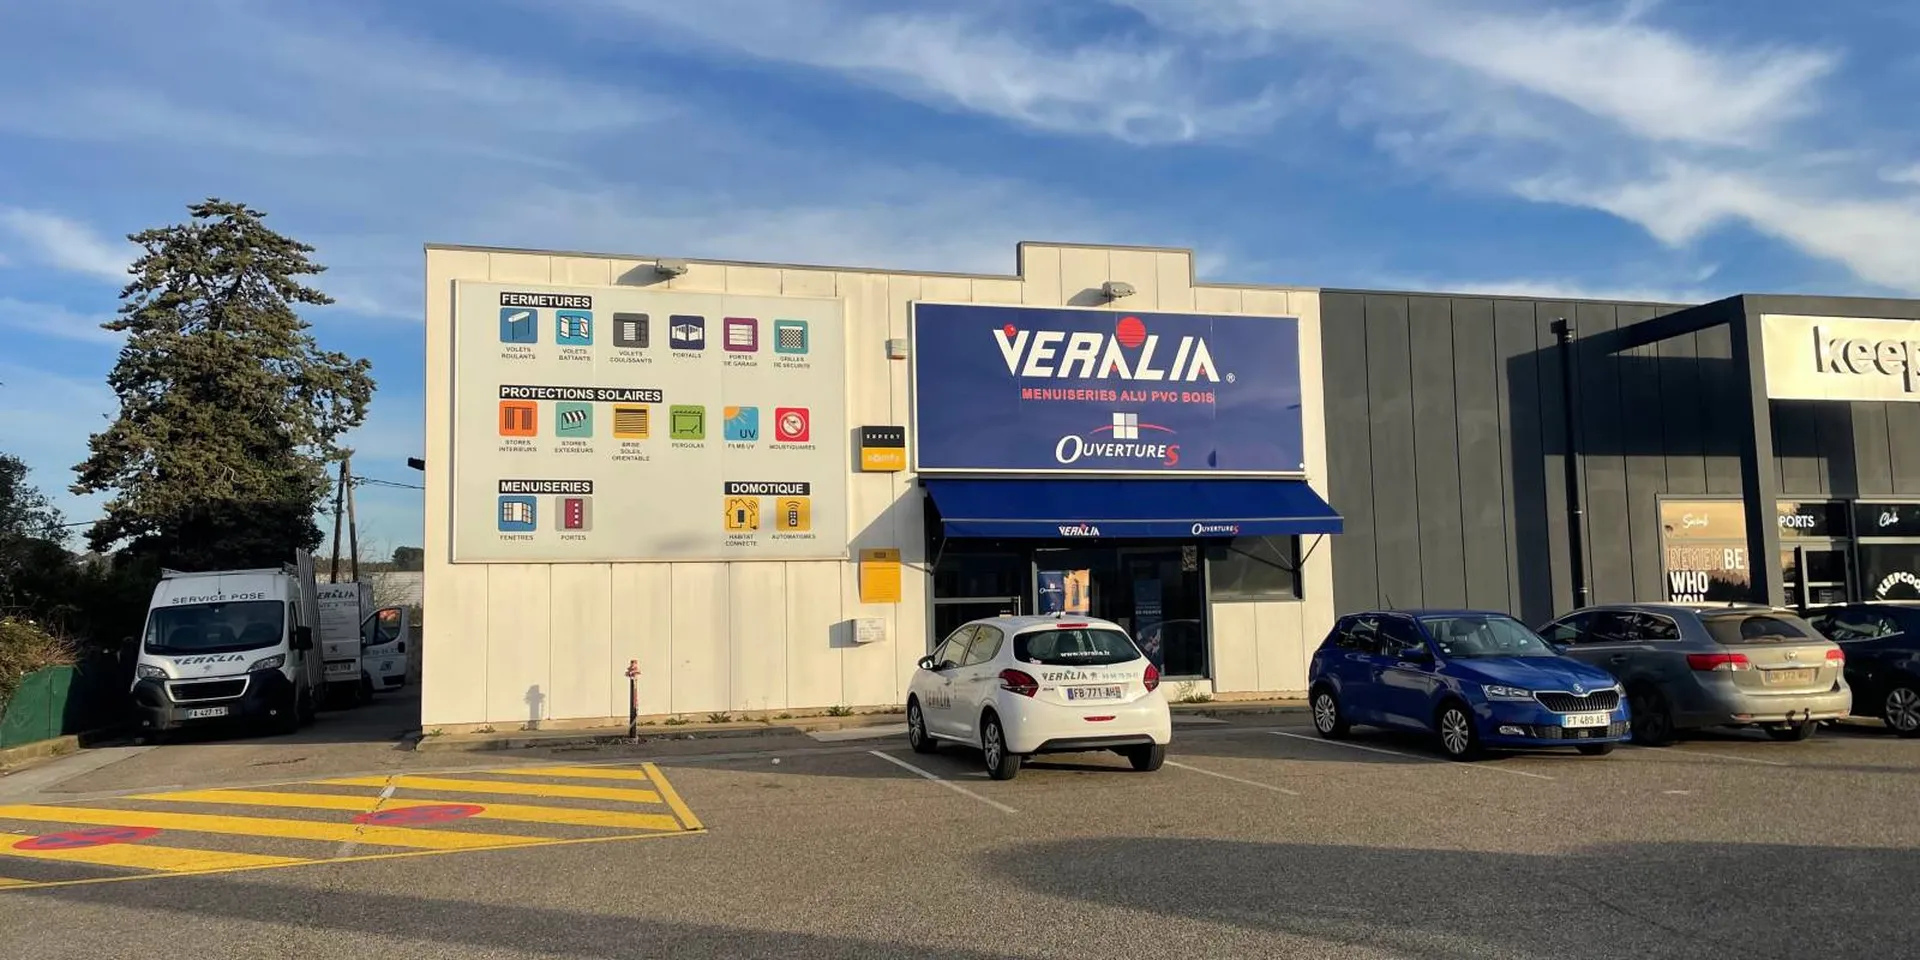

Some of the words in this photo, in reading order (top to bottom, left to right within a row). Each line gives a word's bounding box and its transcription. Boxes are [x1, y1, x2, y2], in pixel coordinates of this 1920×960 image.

[502, 293, 590, 308] FERMETURES
[993, 328, 1221, 383] VERALIA
[501, 387, 594, 399] PROTECTIONS
[597, 390, 661, 401] SOLAIRES
[1022, 388, 1116, 401] MENUISERIES
[1120, 390, 1147, 401] ALU
[1152, 391, 1178, 402] PVC
[1182, 392, 1215, 403] BOIS
[740, 429, 756, 439] UV
[501, 481, 591, 493] MENUISERIES
[731, 483, 804, 495] DOMOTIQUE
[1058, 525, 1100, 536] VERALIA
[1668, 547, 1748, 570] REMEMBE
[1669, 571, 1709, 594] WHO
[1877, 571, 1920, 595] KEEPCOO
[172, 594, 226, 604] SERVICE
[231, 592, 265, 600] POSE
[318, 589, 355, 600] ERALIA
[174, 654, 245, 665] VERALIA
[1041, 670, 1087, 681] VERALIA
